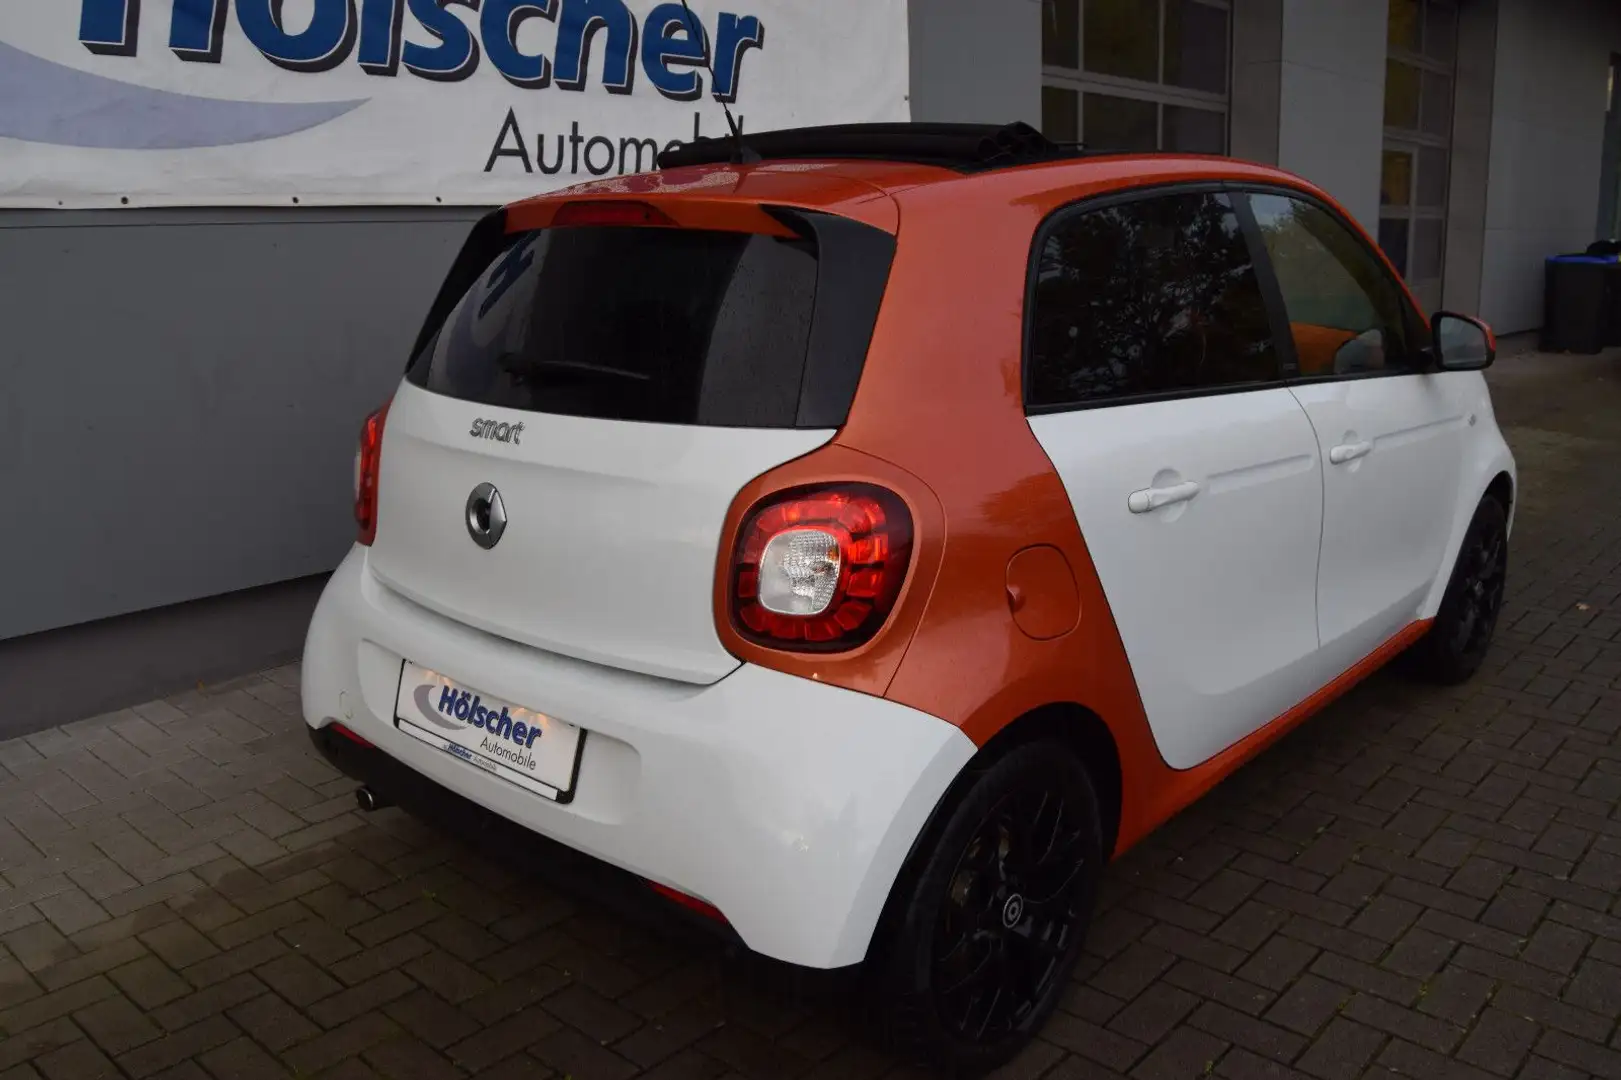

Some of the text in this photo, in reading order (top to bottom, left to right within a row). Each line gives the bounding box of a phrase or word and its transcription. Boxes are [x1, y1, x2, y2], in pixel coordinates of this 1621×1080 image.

[484, 106, 743, 175] Autom
[469, 417, 525, 445] smart
[438, 685, 542, 749] Hölscher
[480, 736, 536, 770] Automobile
